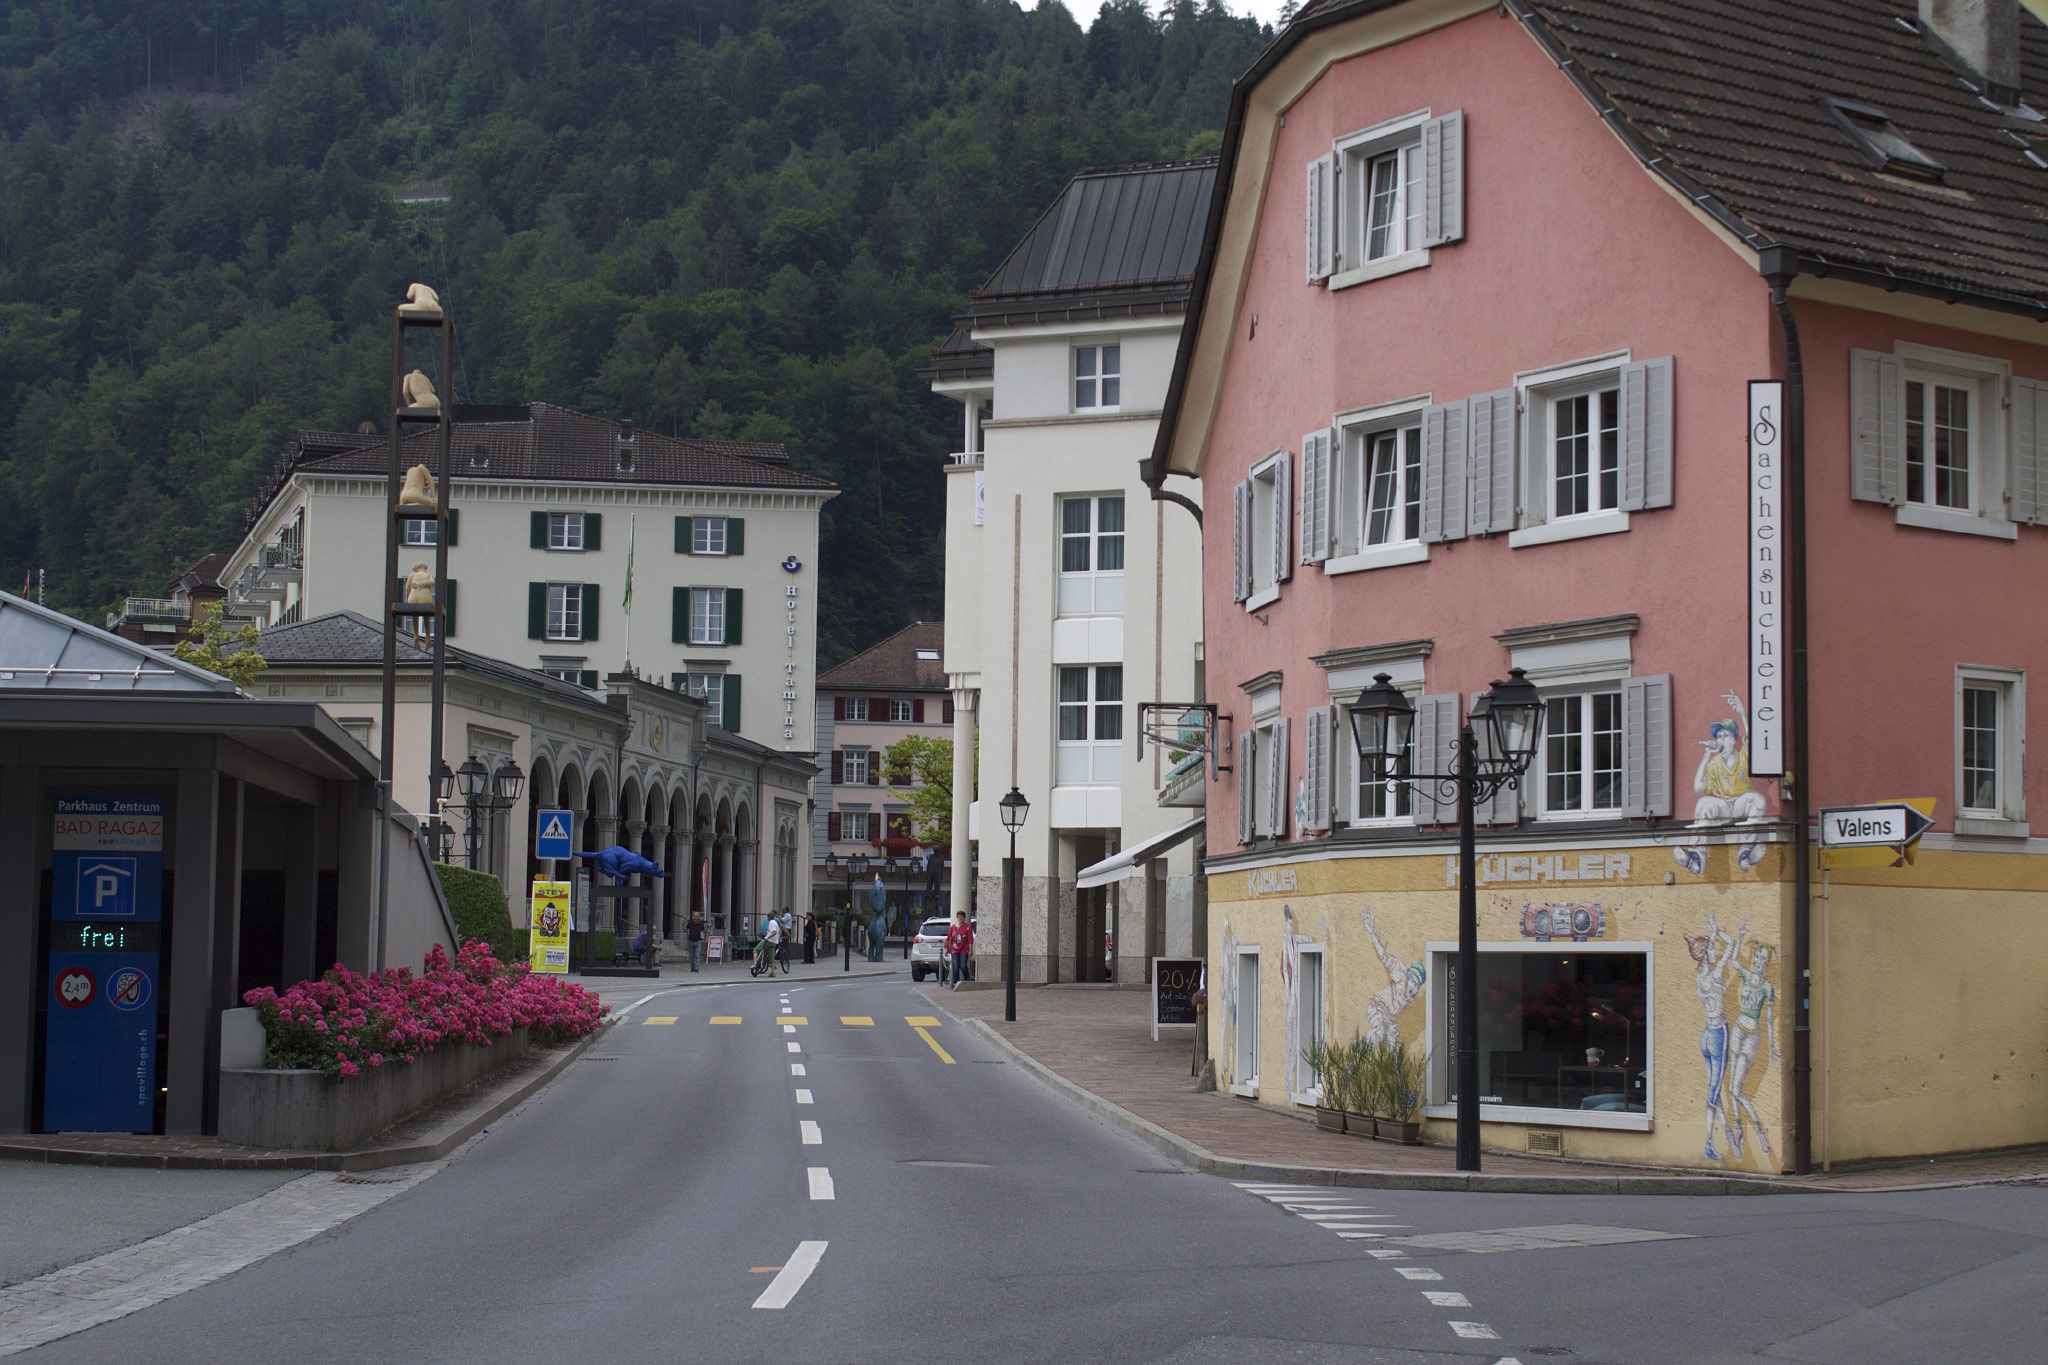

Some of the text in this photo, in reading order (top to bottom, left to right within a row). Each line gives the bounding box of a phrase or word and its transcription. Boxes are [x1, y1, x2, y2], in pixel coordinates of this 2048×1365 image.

[1753, 404, 1777, 751] Sachensucherei
[785, 585, 797, 648] Hotel
[782, 662, 796, 739] Tamina
[58, 800, 160, 812] Parkhaus Zentrum
[56, 820, 161, 836] BAD RAGAZ
[1836, 817, 1892, 838] Valens
[80, 925, 125, 948] frei
[1160, 991, 1172, 1000] Auf
[137, 1029, 149, 1105] spavillage.ch
